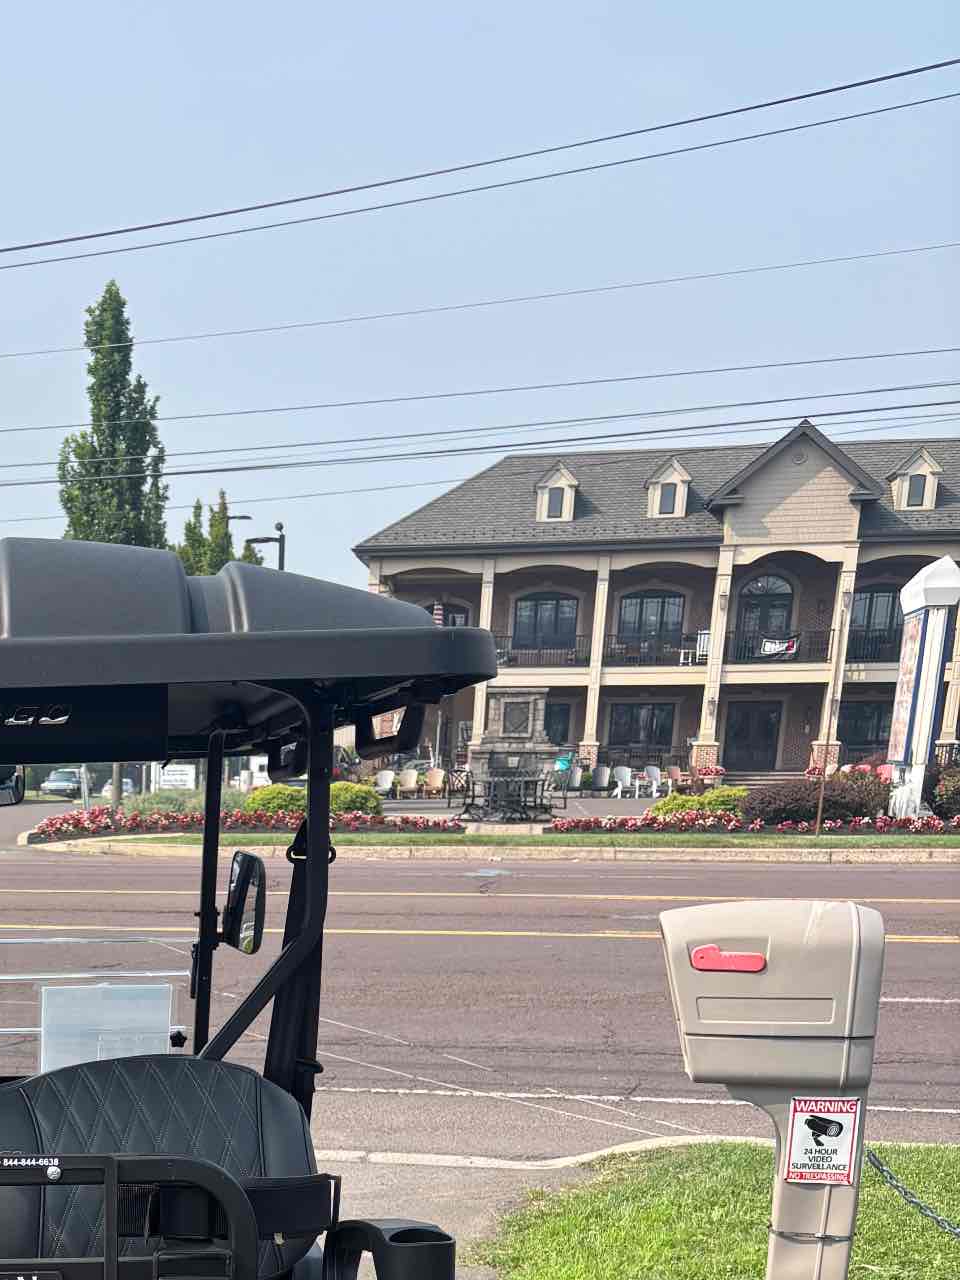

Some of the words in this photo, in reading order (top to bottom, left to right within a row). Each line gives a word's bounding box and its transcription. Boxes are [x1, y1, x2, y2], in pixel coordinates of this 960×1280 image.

[795, 1100, 857, 1112] WARNING
[3, 1158, 59, 1166] 844-844-6638
[791, 1163, 848, 1171] SURVEILLANCE
